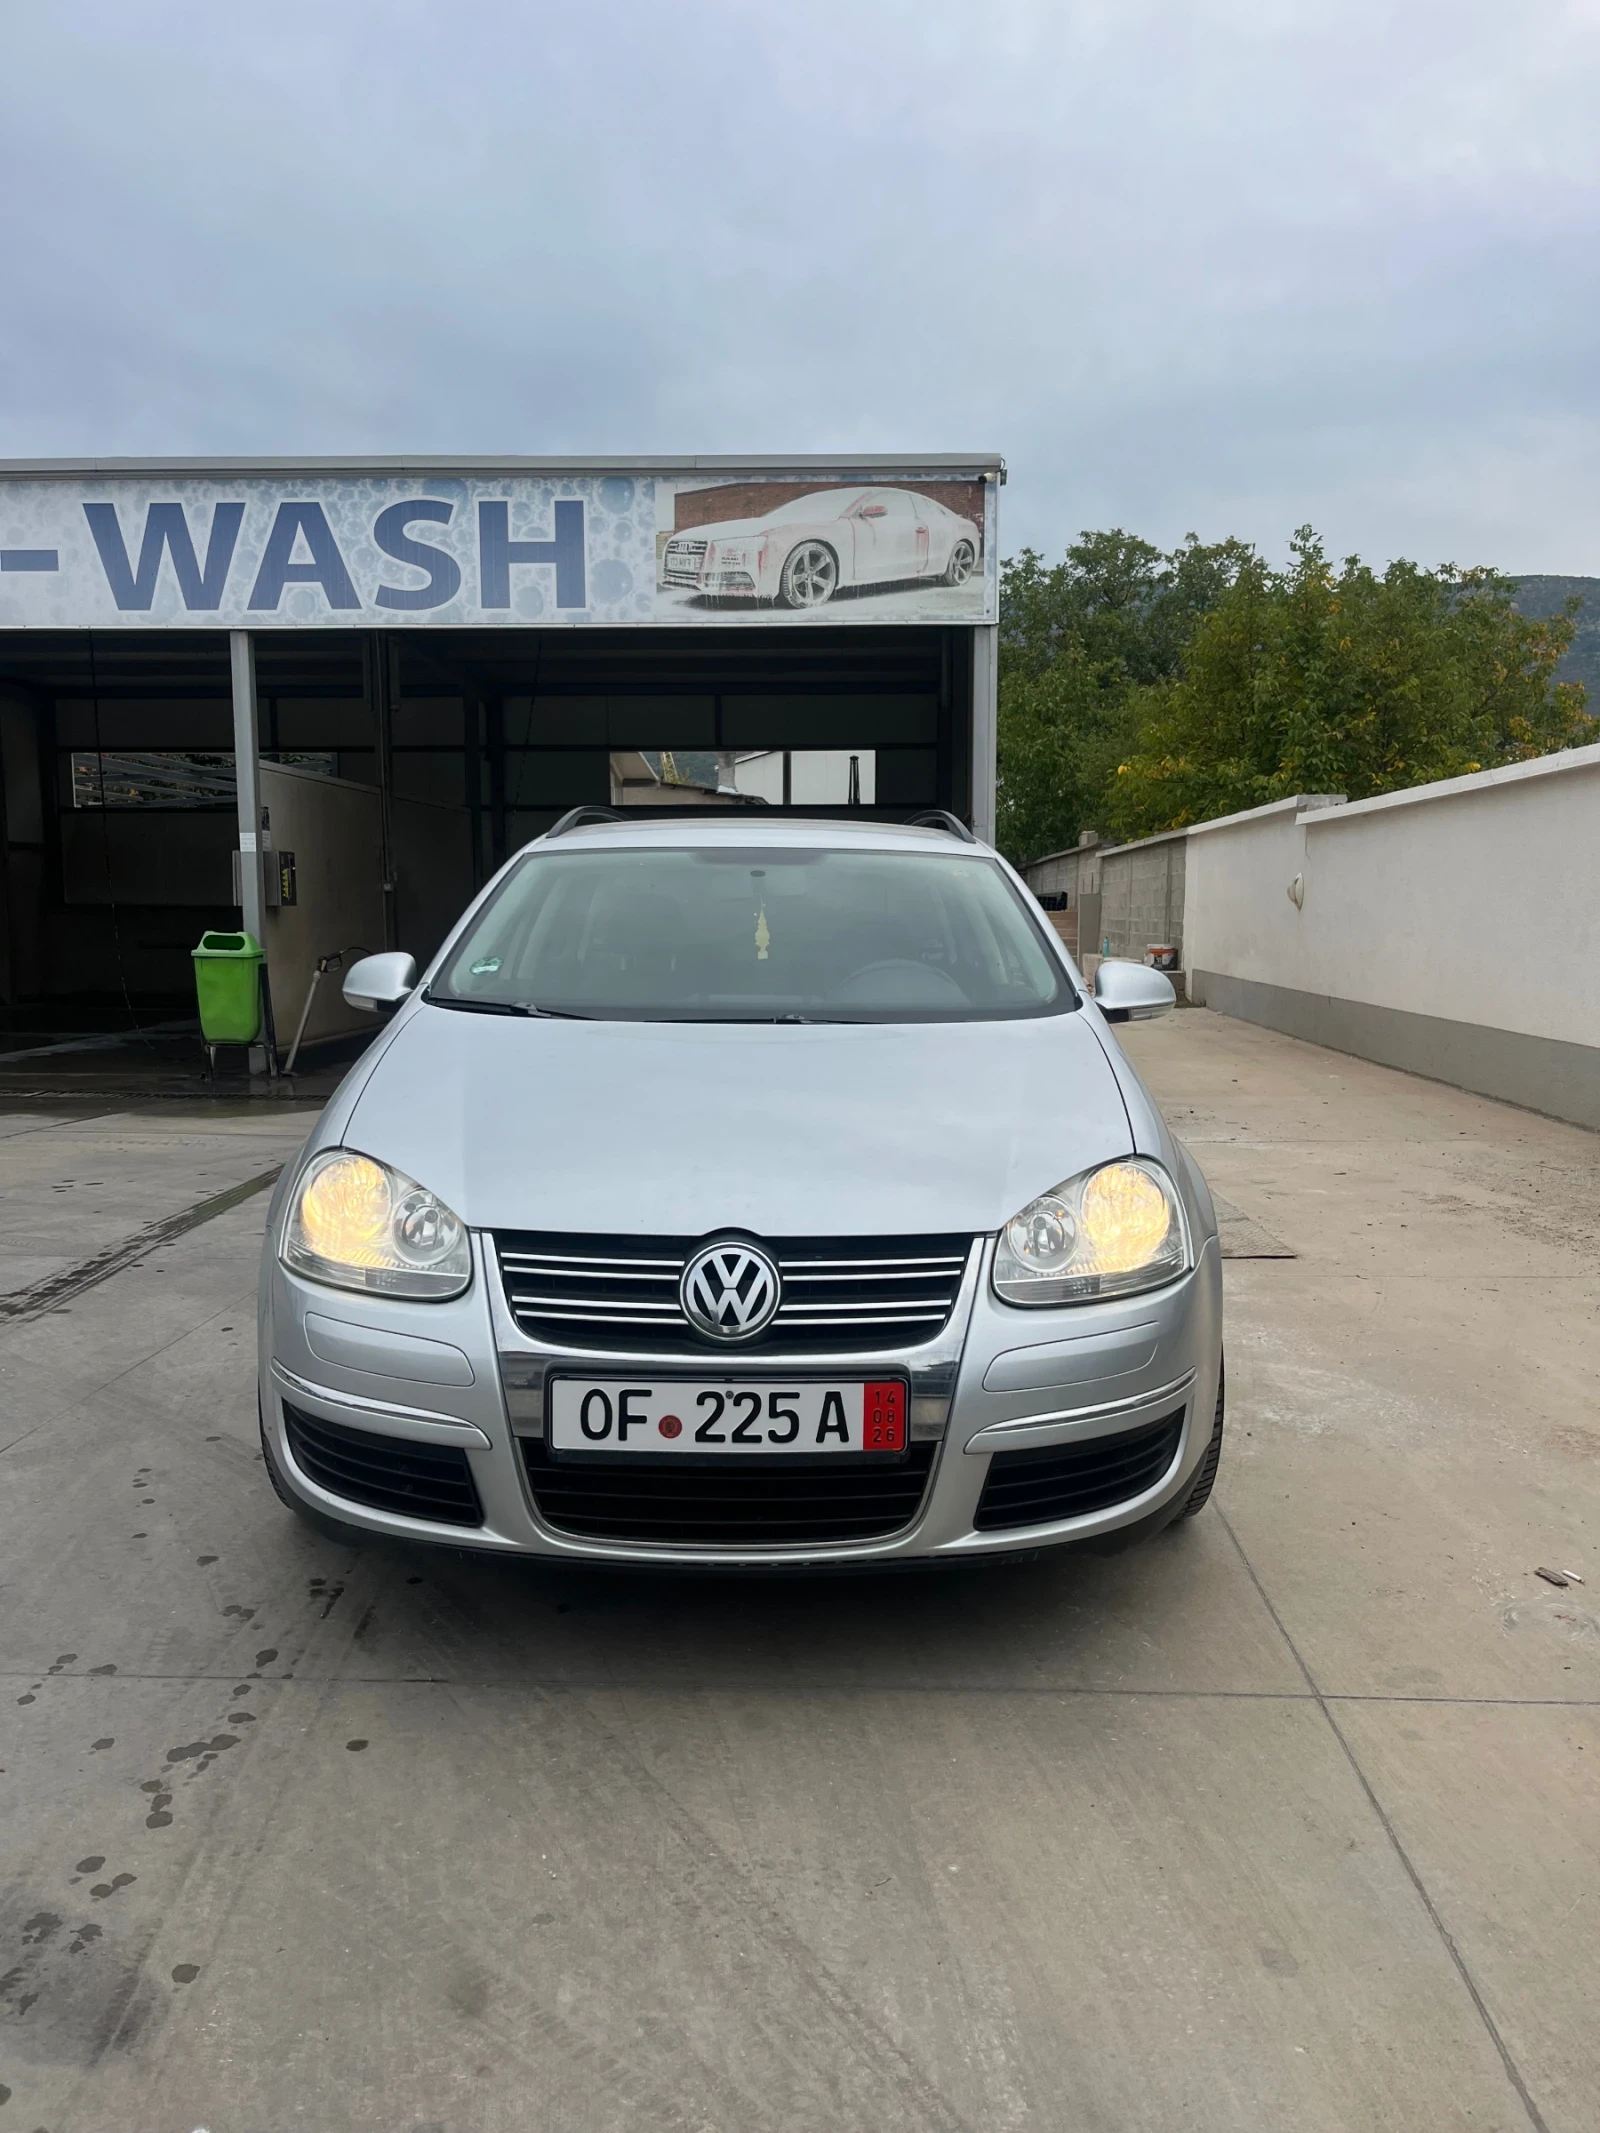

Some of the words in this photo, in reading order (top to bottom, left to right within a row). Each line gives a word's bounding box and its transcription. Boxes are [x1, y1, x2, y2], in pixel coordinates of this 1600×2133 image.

[580, 1388, 652, 1441] OF
[695, 1391, 800, 1444] 225
[815, 1391, 849, 1443] A
